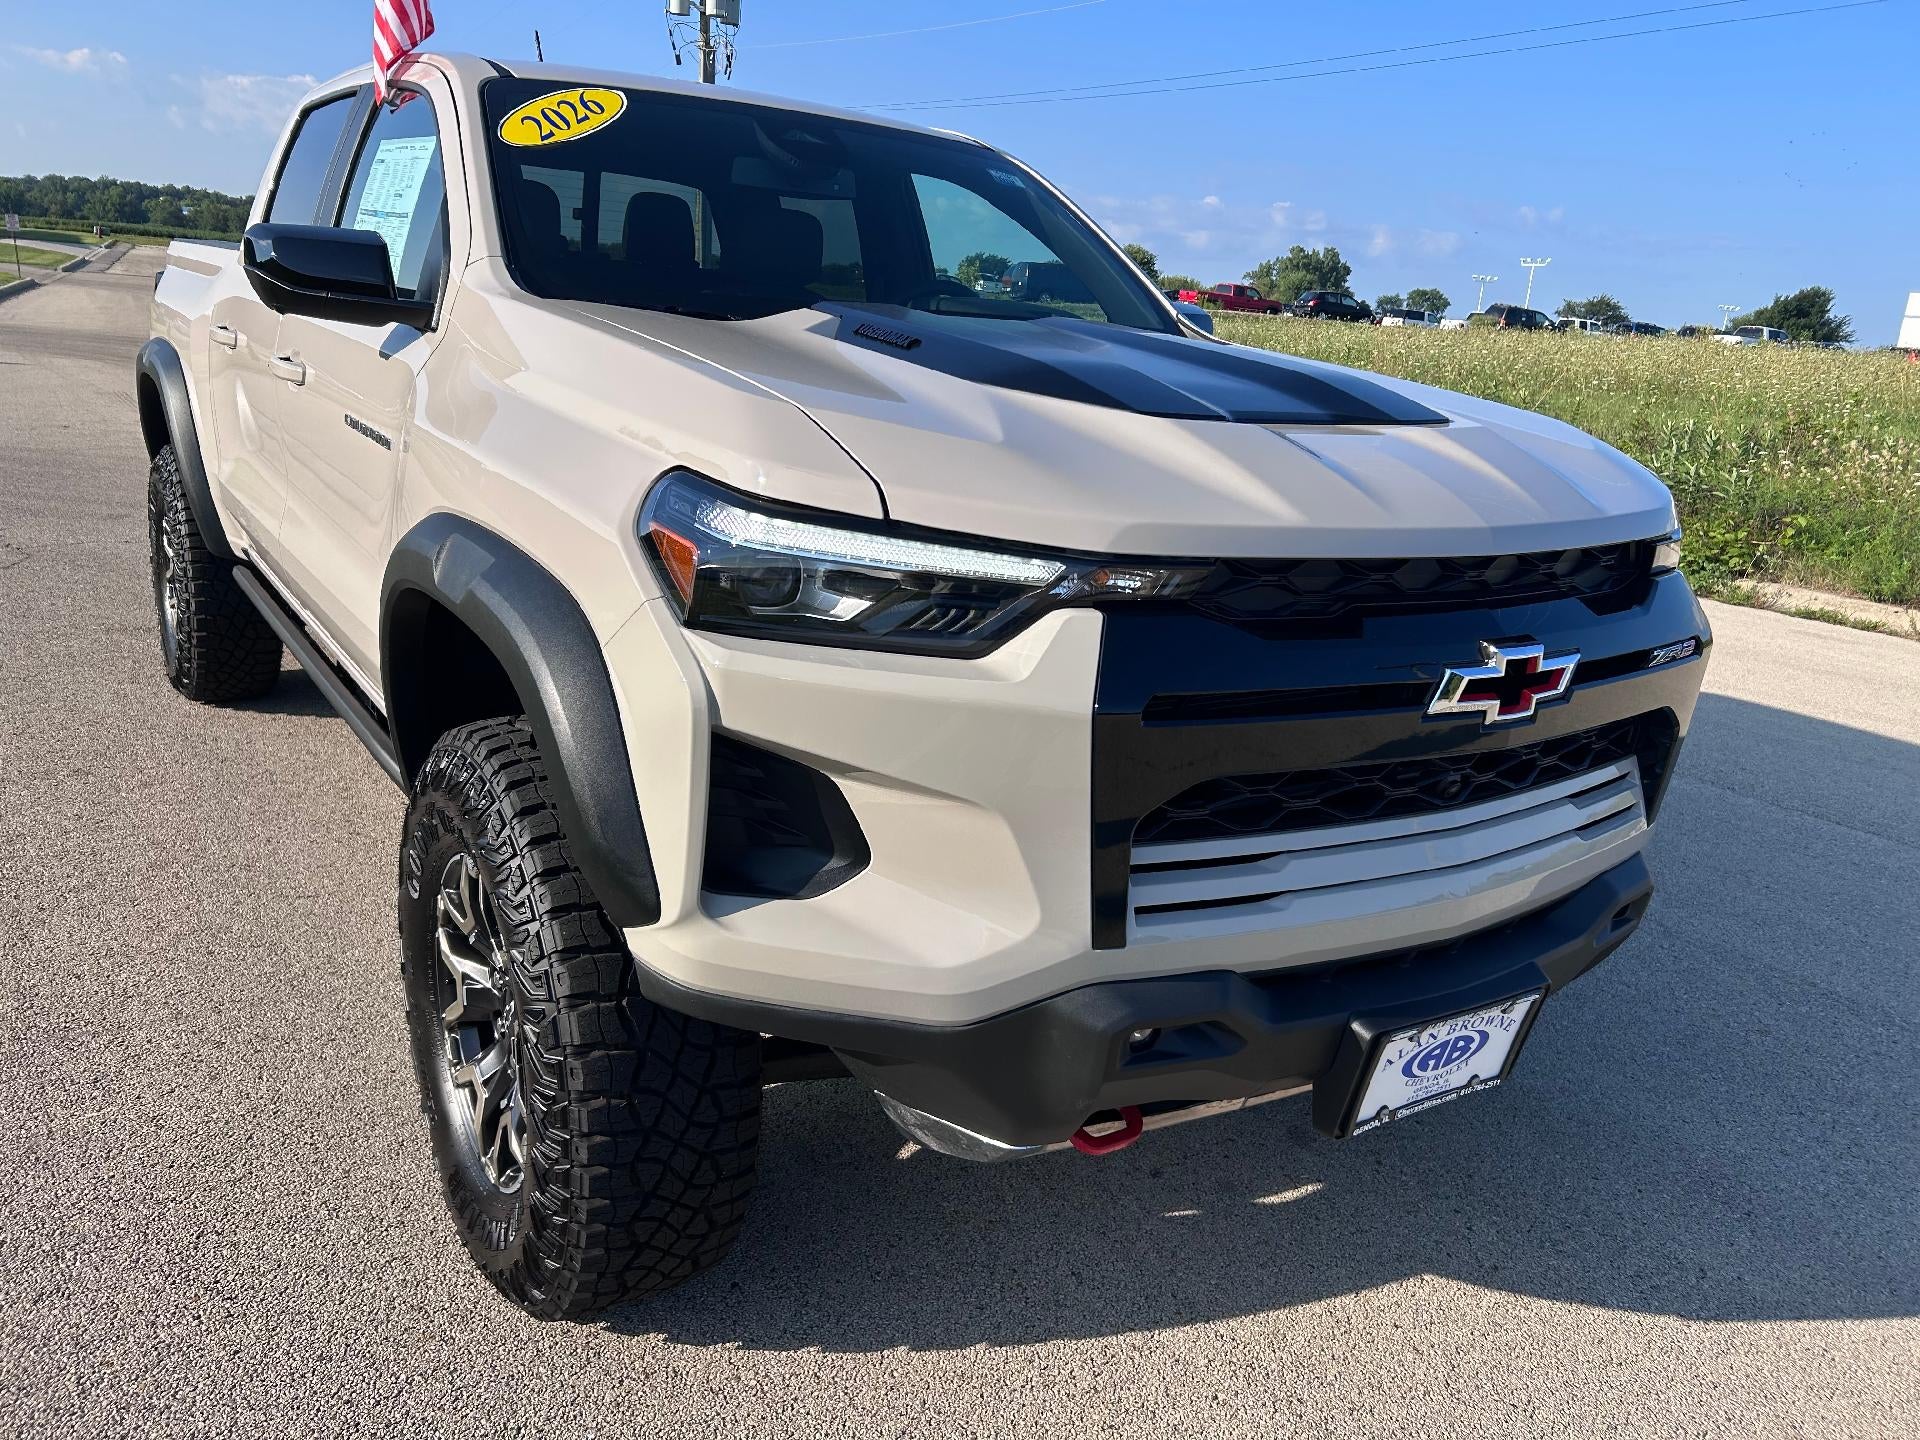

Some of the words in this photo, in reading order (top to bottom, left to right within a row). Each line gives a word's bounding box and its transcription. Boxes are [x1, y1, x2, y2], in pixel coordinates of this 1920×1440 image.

[521, 90, 605, 142] 2026
[1648, 639, 1696, 667] ZR2
[1381, 1029, 1441, 1073] ALAN
[1445, 1014, 1517, 1036] BROWNE
[1416, 1034, 1476, 1073] AB
[1404, 1059, 1470, 1087] CHEVROLET
[1352, 1119, 1381, 1136] GENOA,
